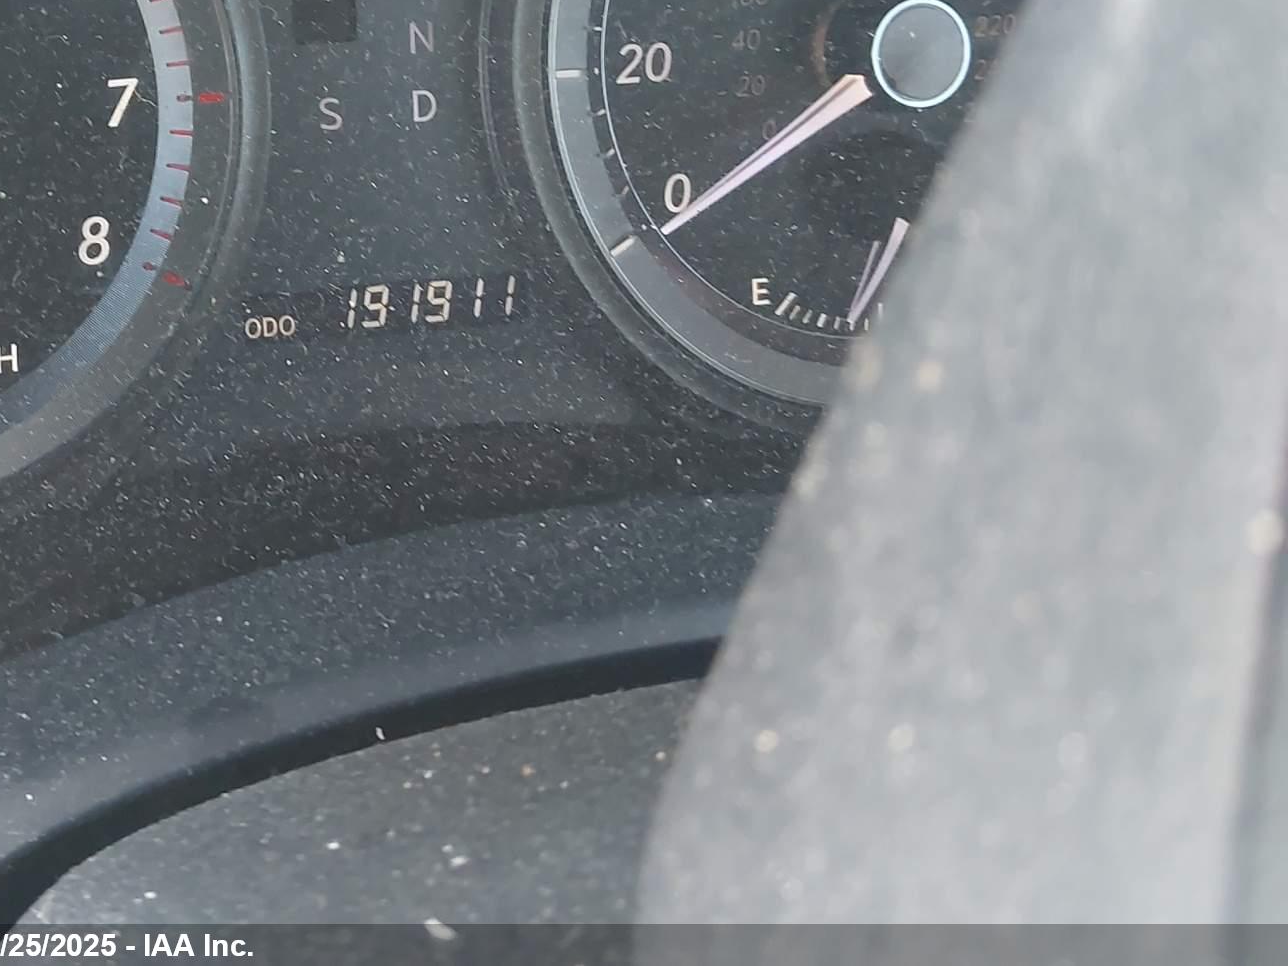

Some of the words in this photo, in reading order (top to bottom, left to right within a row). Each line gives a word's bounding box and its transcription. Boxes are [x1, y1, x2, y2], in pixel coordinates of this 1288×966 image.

[409, 21, 435, 55] N
[731, 29, 761, 51] 40
[616, 41, 673, 85] 20
[106, 77, 140, 128] 7
[735, 74, 766, 98] 20
[318, 97, 344, 132] S
[412, 89, 438, 124] D
[663, 173, 692, 213] 0
[78, 216, 112, 266] 8
[346, 275, 516, 330] 191911
[751, 277, 771, 306] E
[244, 314, 296, 339] ODO
